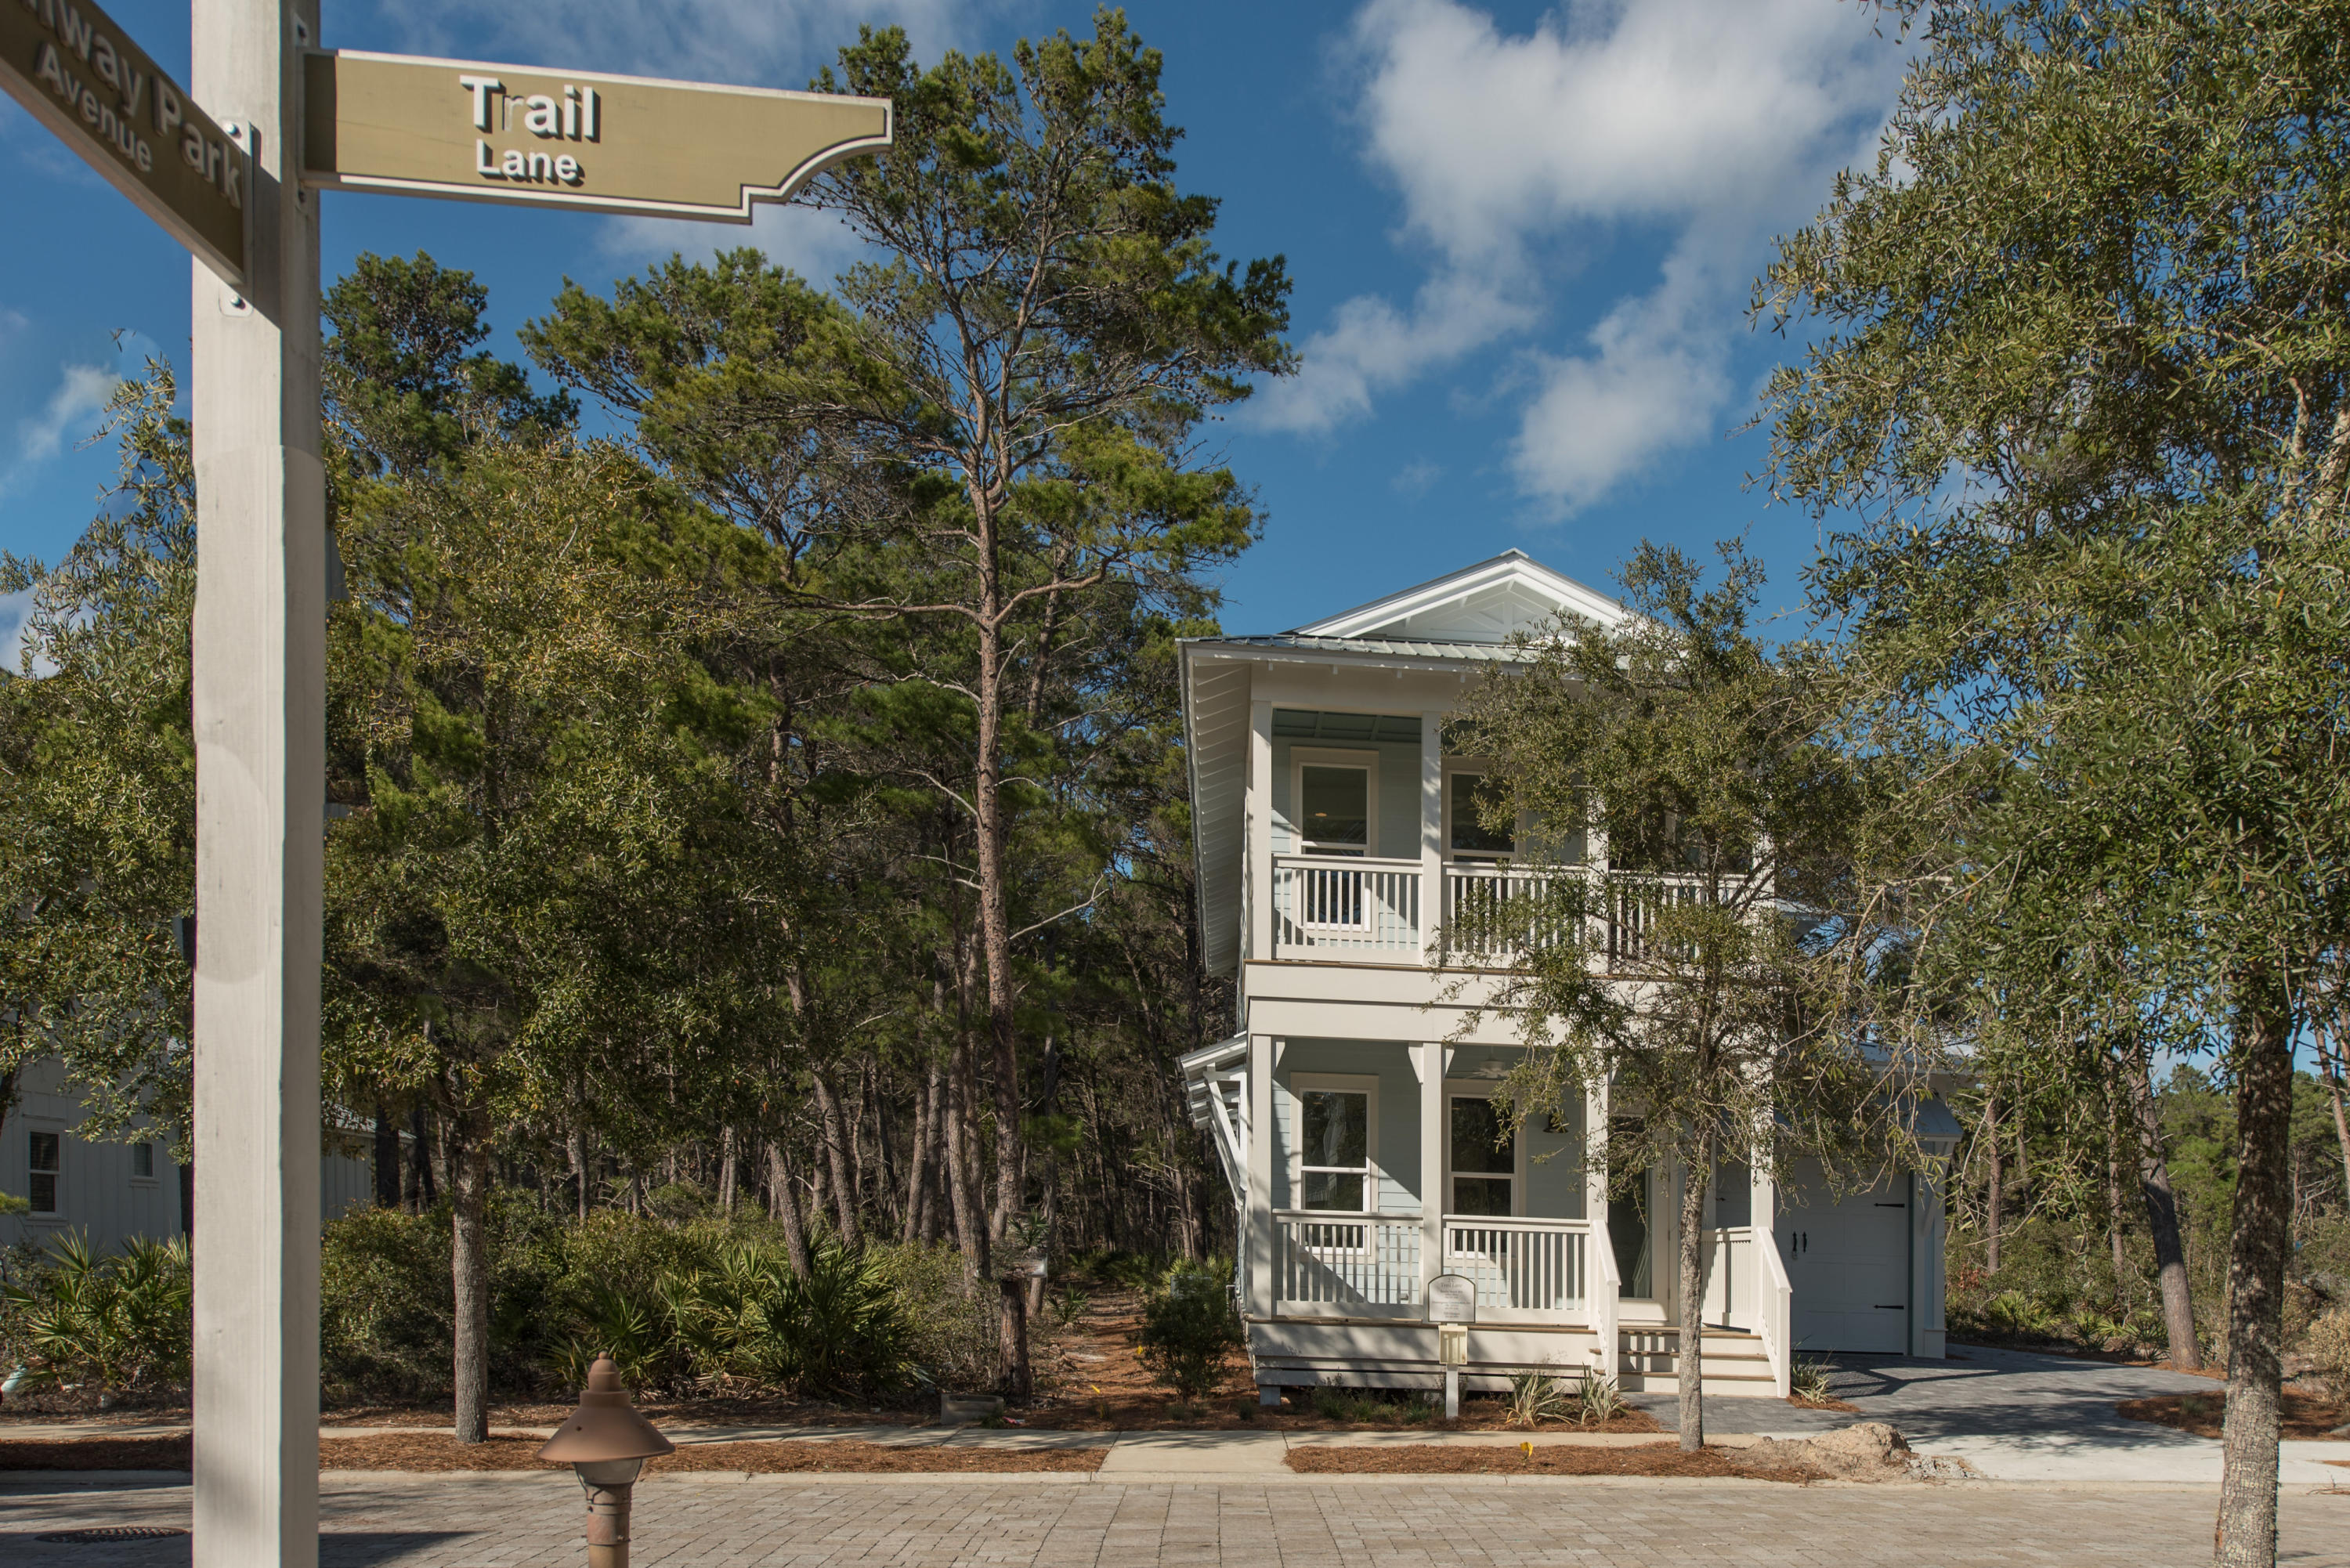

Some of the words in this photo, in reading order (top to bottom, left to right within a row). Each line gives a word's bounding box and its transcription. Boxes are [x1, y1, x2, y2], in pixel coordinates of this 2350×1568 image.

[37, 43, 153, 172] Avenue
[152, 77, 242, 209] Park
[459, 74, 596, 139] Trail
[476, 139, 580, 182] Lane
